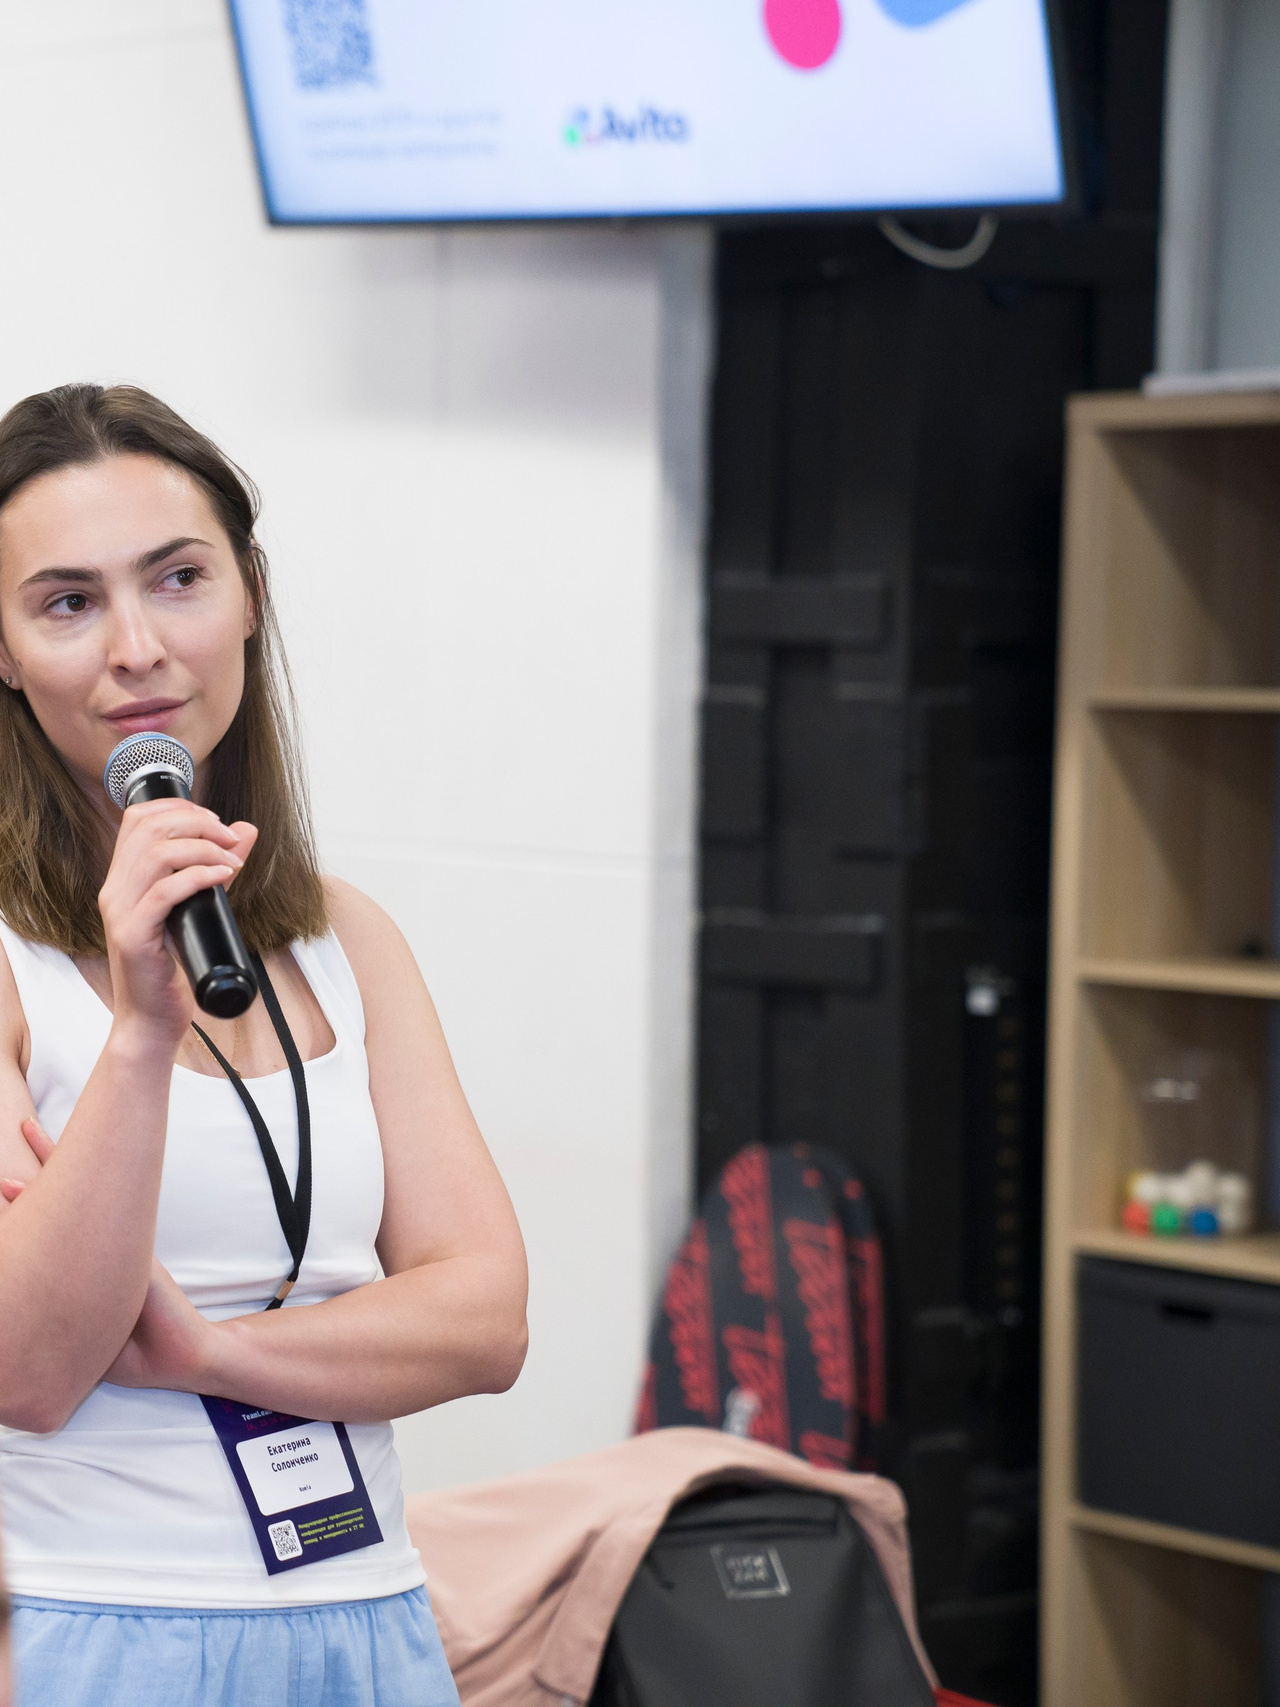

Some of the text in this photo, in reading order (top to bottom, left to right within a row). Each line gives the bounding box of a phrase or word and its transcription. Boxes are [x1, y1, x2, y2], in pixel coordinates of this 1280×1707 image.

[600, 104, 690, 143] Avito
[267, 1437, 311, 1456] Екатерина
[271, 1452, 319, 1472] Солонченко
